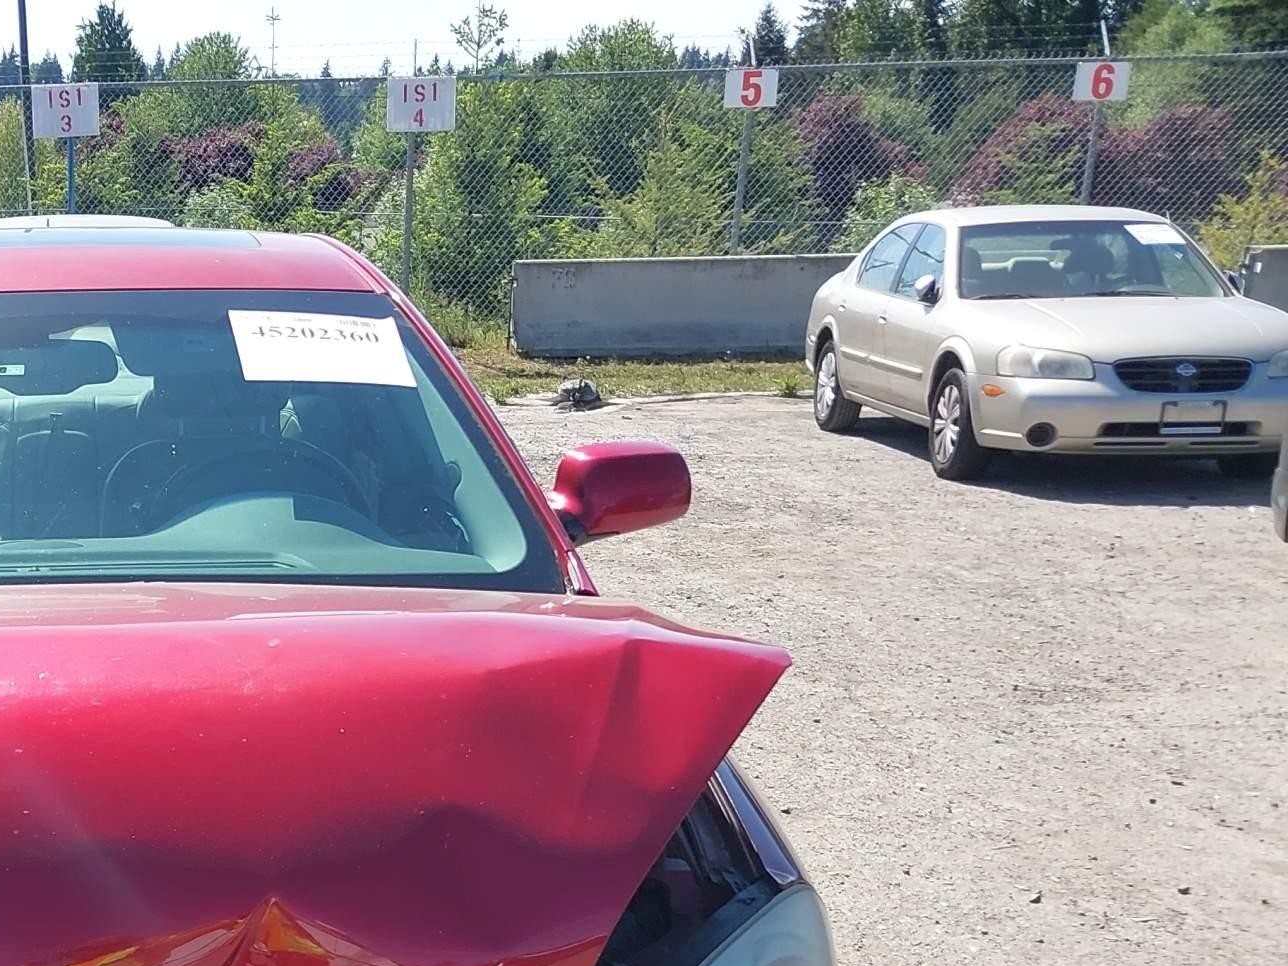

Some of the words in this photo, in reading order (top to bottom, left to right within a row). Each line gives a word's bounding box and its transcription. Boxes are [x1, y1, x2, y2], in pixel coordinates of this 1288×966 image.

[740, 70, 763, 107] 5
[1091, 63, 1116, 99] 6
[60, 114, 72, 133] 3
[413, 108, 424, 127] 4
[251, 325, 380, 343] 45202360
